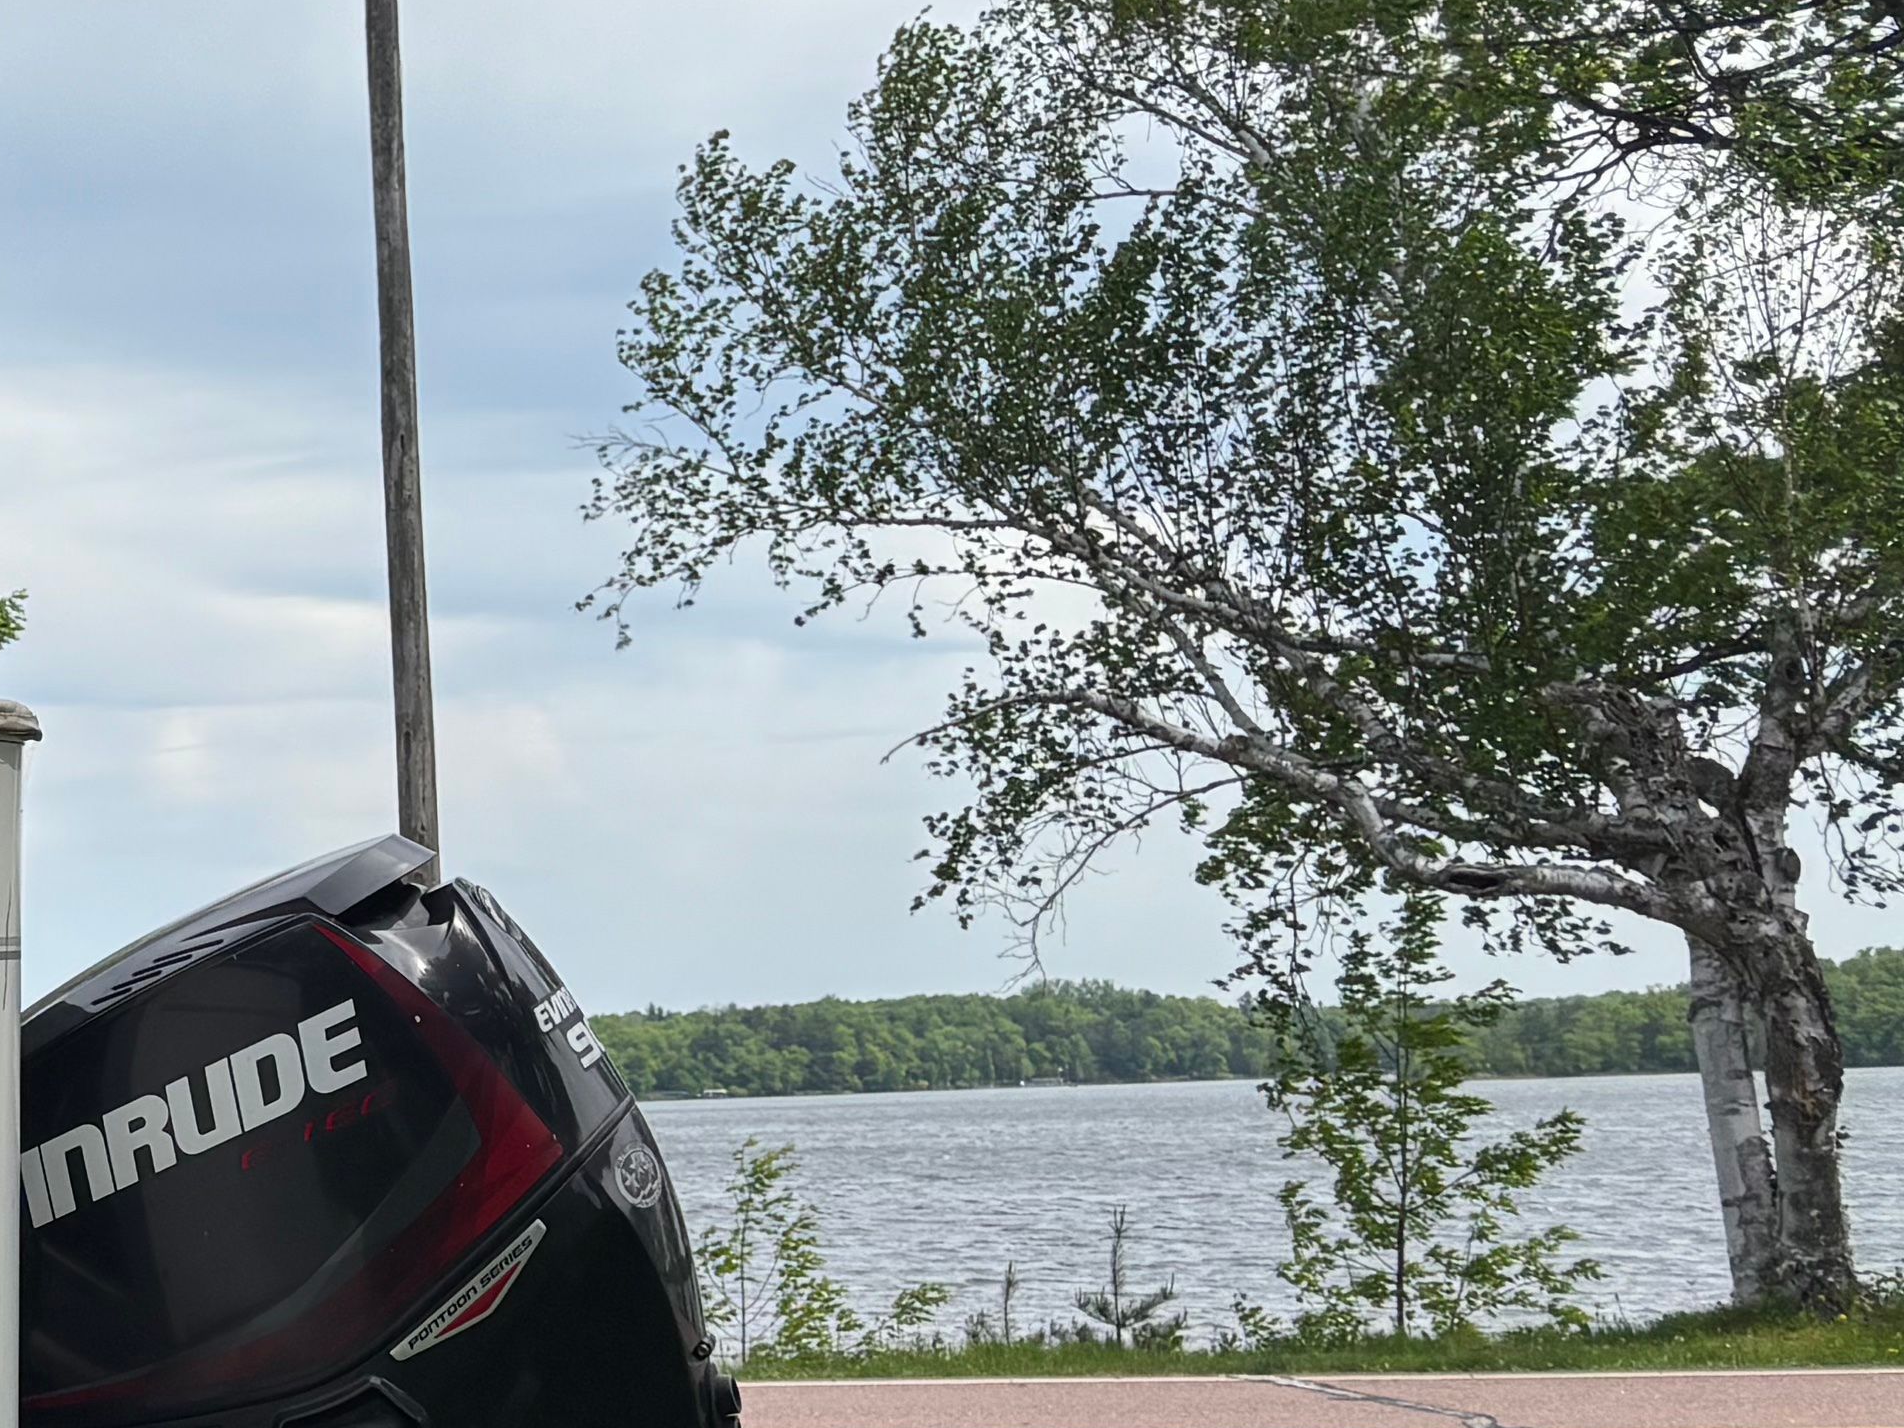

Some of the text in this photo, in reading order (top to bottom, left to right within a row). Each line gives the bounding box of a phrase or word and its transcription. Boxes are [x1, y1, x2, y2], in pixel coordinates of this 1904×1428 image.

[20, 998, 368, 1229] INRUDE
[407, 1234, 533, 1351] PONTOON SERIES
